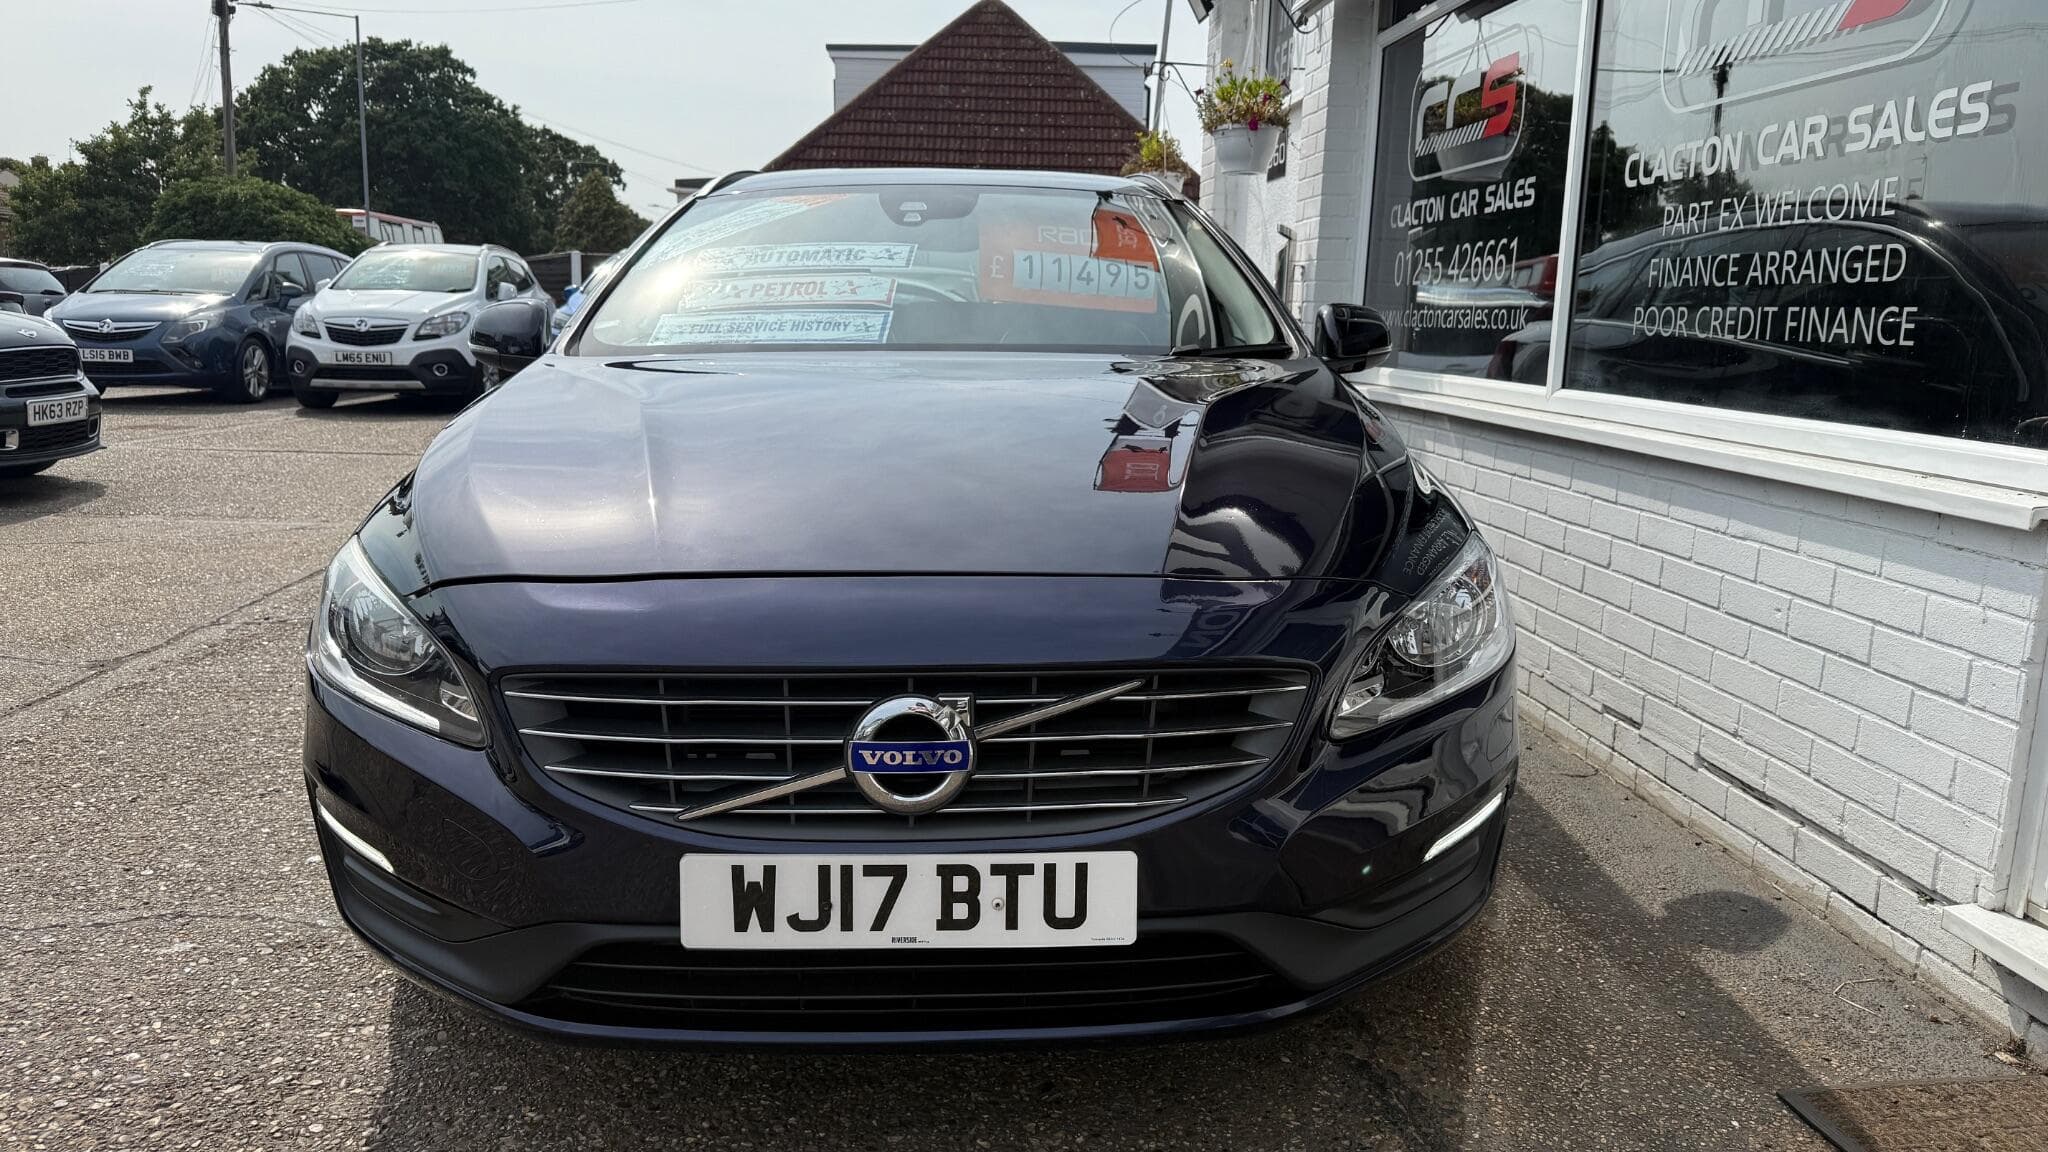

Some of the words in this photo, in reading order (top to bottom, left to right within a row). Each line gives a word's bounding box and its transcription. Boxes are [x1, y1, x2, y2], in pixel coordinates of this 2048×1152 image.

[1624, 130, 1744, 189] CLACTON
[1757, 115, 1829, 168] CAR
[1844, 80, 1995, 153] SALES
[1391, 195, 1445, 229] CLACTON
[1450, 188, 1479, 220] CAR
[1484, 176, 1537, 213] SALES
[1662, 200, 1715, 237] PART
[1718, 197, 1746, 231] EX
[1755, 176, 1900, 228] WELCOME
[746, 248, 865, 265] AUTOMATIC
[990, 255, 1005, 279] £
[1022, 254, 1150, 291] 11495
[1394, 246, 1443, 289] 01255
[1447, 236, 1520, 285] 426661
[1648, 254, 1749, 289] FINANCE
[1745, 243, 1908, 286] ARRANGED
[750, 280, 828, 298] PETROL
[689, 322, 722, 335] FULL
[727, 320, 788, 334] SERVICE
[789, 318, 852, 332] HISTORY
[1632, 306, 1690, 338] POOR
[1694, 306, 1779, 341] CREDIT
[1784, 306, 1919, 348] FINANCE
[335, 353, 362, 363] LM65
[365, 353, 386, 363] ENU
[33, 403, 63, 421] HK63
[66, 400, 84, 417] RZP
[858, 748, 964, 767] VOLVO
[731, 864, 908, 933] WJ17
[935, 862, 1090, 931] BTU
[891, 936, 917, 944] RIVERSIDE
